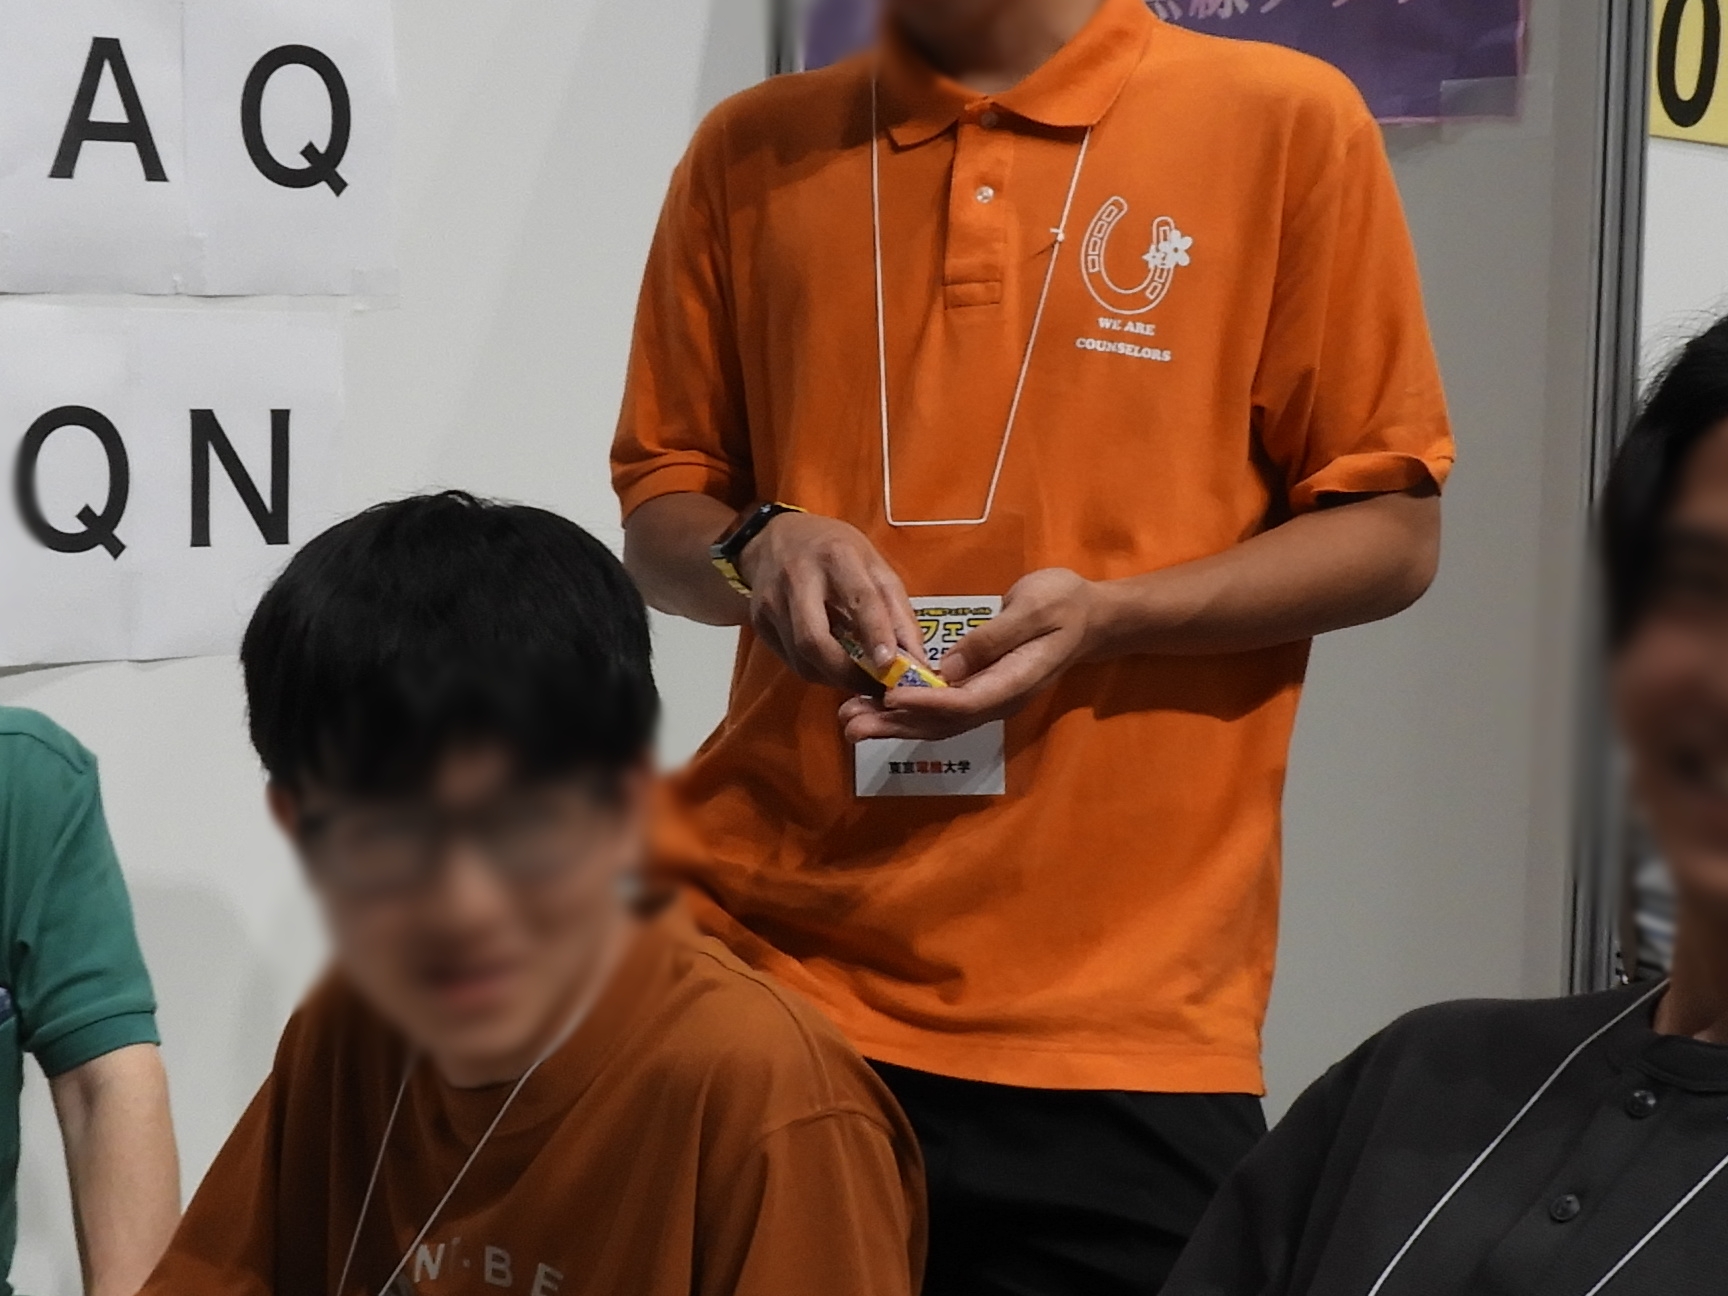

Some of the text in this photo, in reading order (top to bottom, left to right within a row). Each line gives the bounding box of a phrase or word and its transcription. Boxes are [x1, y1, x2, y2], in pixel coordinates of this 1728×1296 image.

[1097, 316, 1156, 336] WE ARE
[1075, 337, 1172, 362] COUNSELORS
